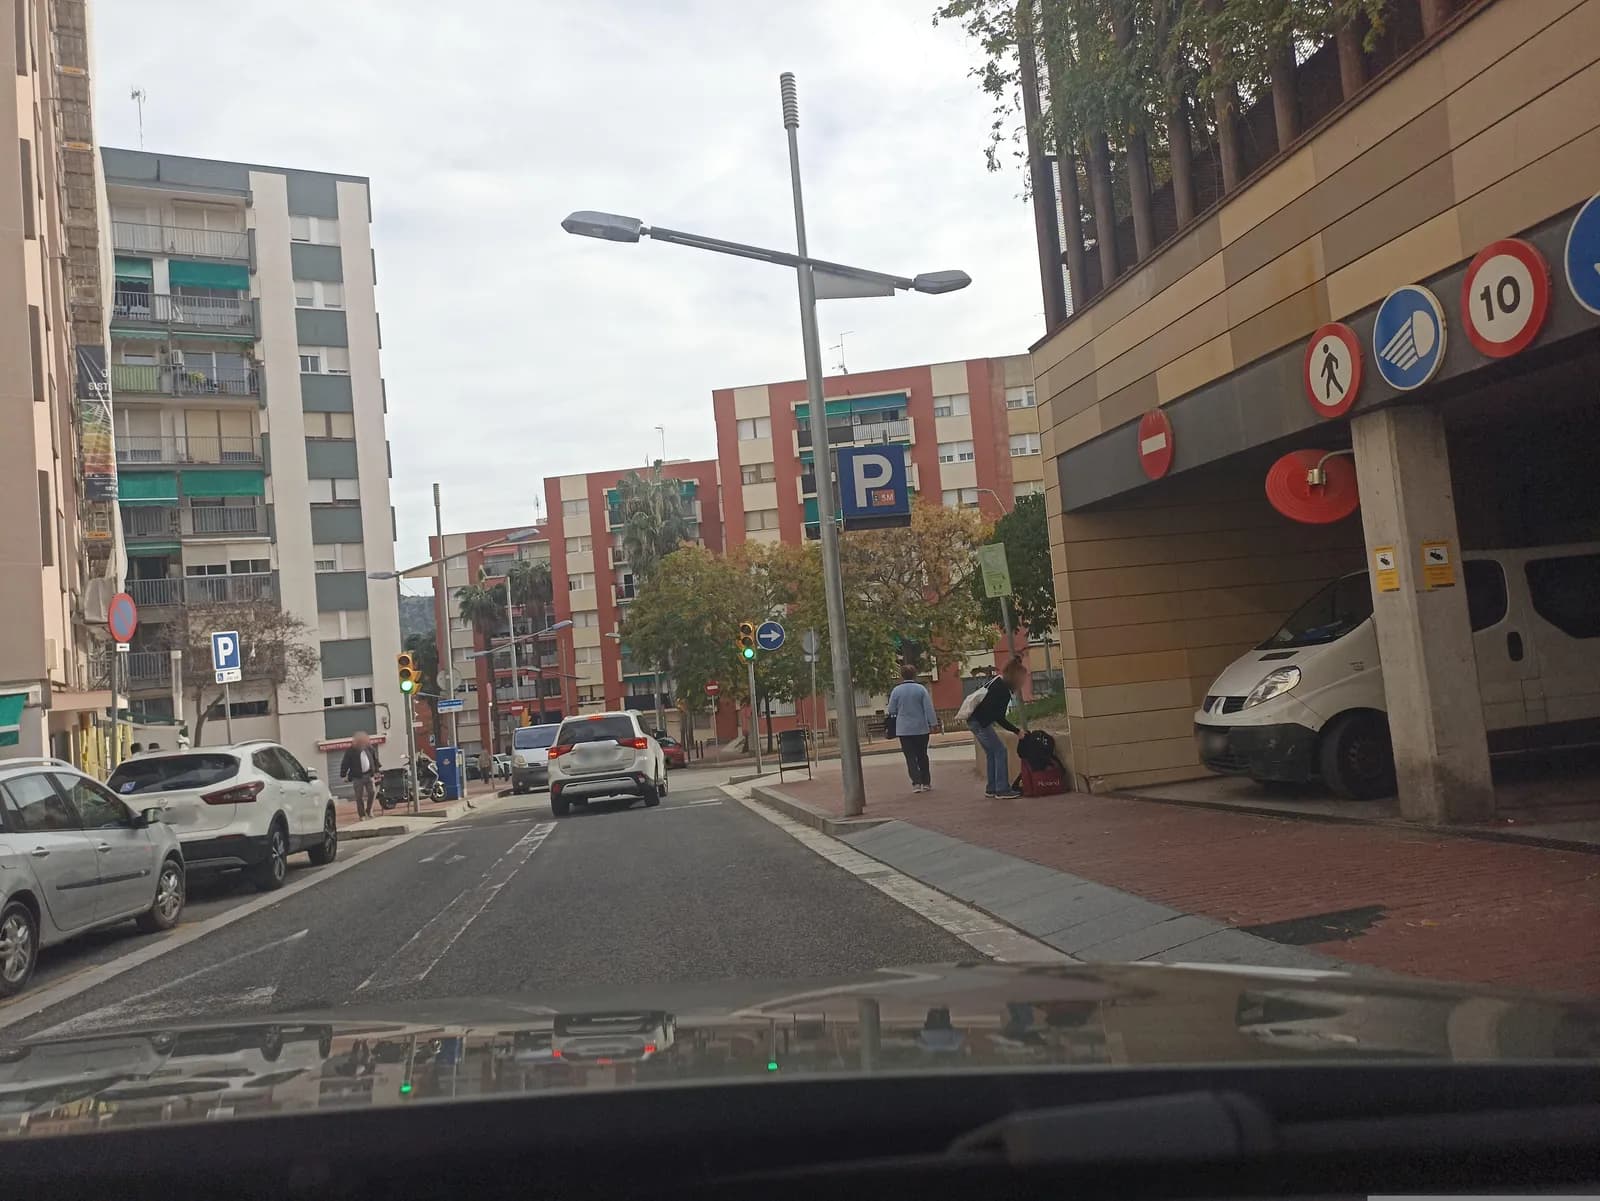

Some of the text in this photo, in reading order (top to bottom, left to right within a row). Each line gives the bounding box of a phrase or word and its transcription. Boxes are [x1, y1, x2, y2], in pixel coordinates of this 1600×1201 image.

[1480, 275, 1521, 322] 10
[852, 454, 893, 508] P
[217, 636, 234, 666] P
